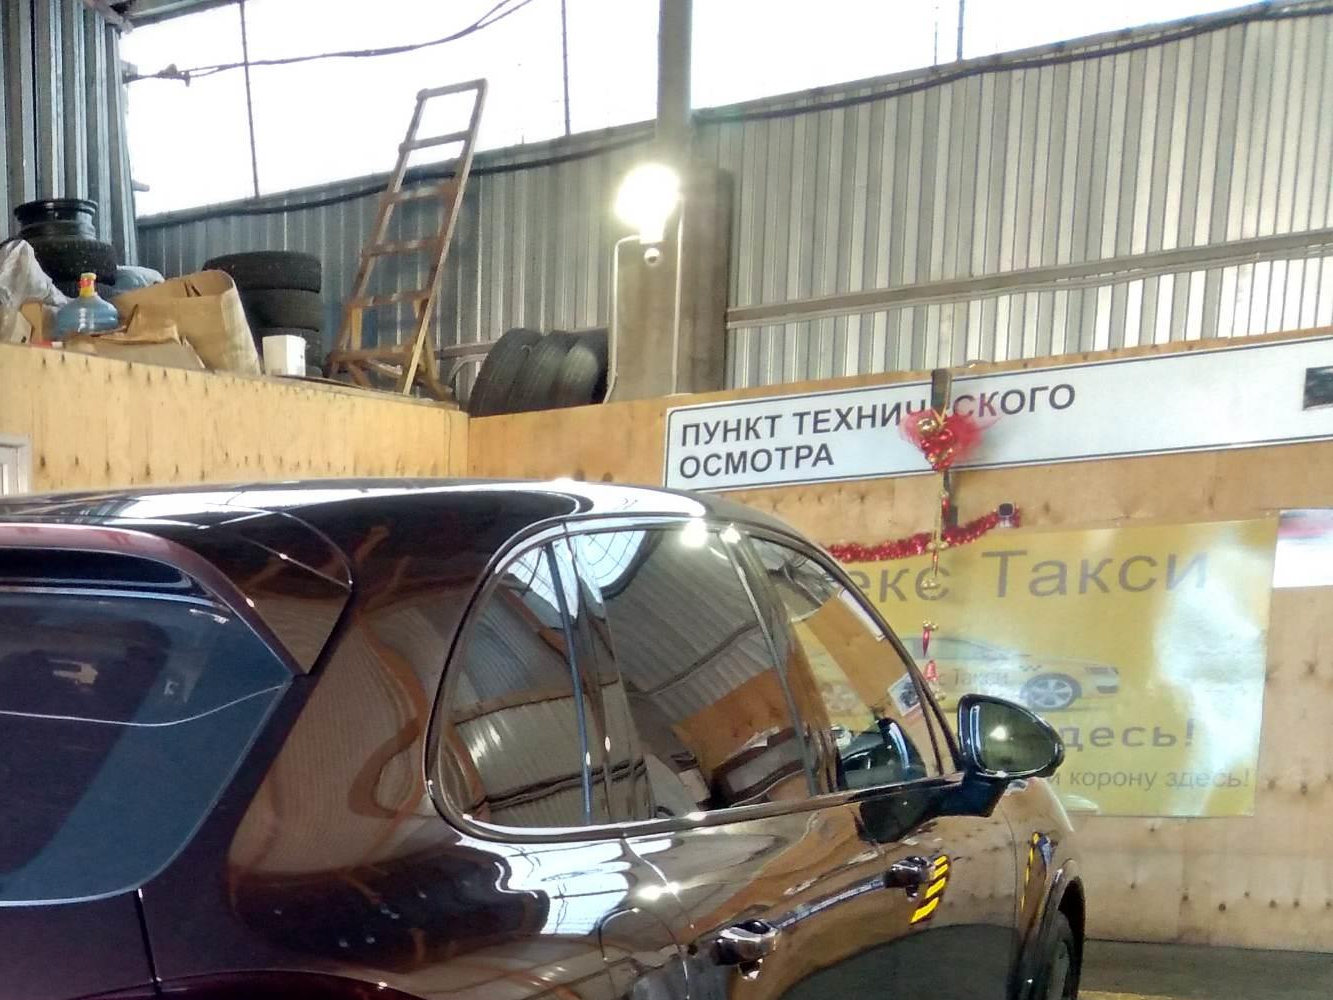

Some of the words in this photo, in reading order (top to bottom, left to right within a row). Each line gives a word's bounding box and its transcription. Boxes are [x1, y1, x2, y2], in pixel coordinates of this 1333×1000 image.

[680, 415, 779, 447] ПУНКТ
[791, 383, 1077, 436] ТЕХНИЧСКОГО
[679, 443, 834, 479] ОСМОТРА
[847, 566, 952, 603] екс
[981, 550, 1209, 599] Такси
[1059, 718, 1196, 752] десь!
[1069, 769, 1158, 792] корону
[1166, 768, 1251, 789] здесь!
